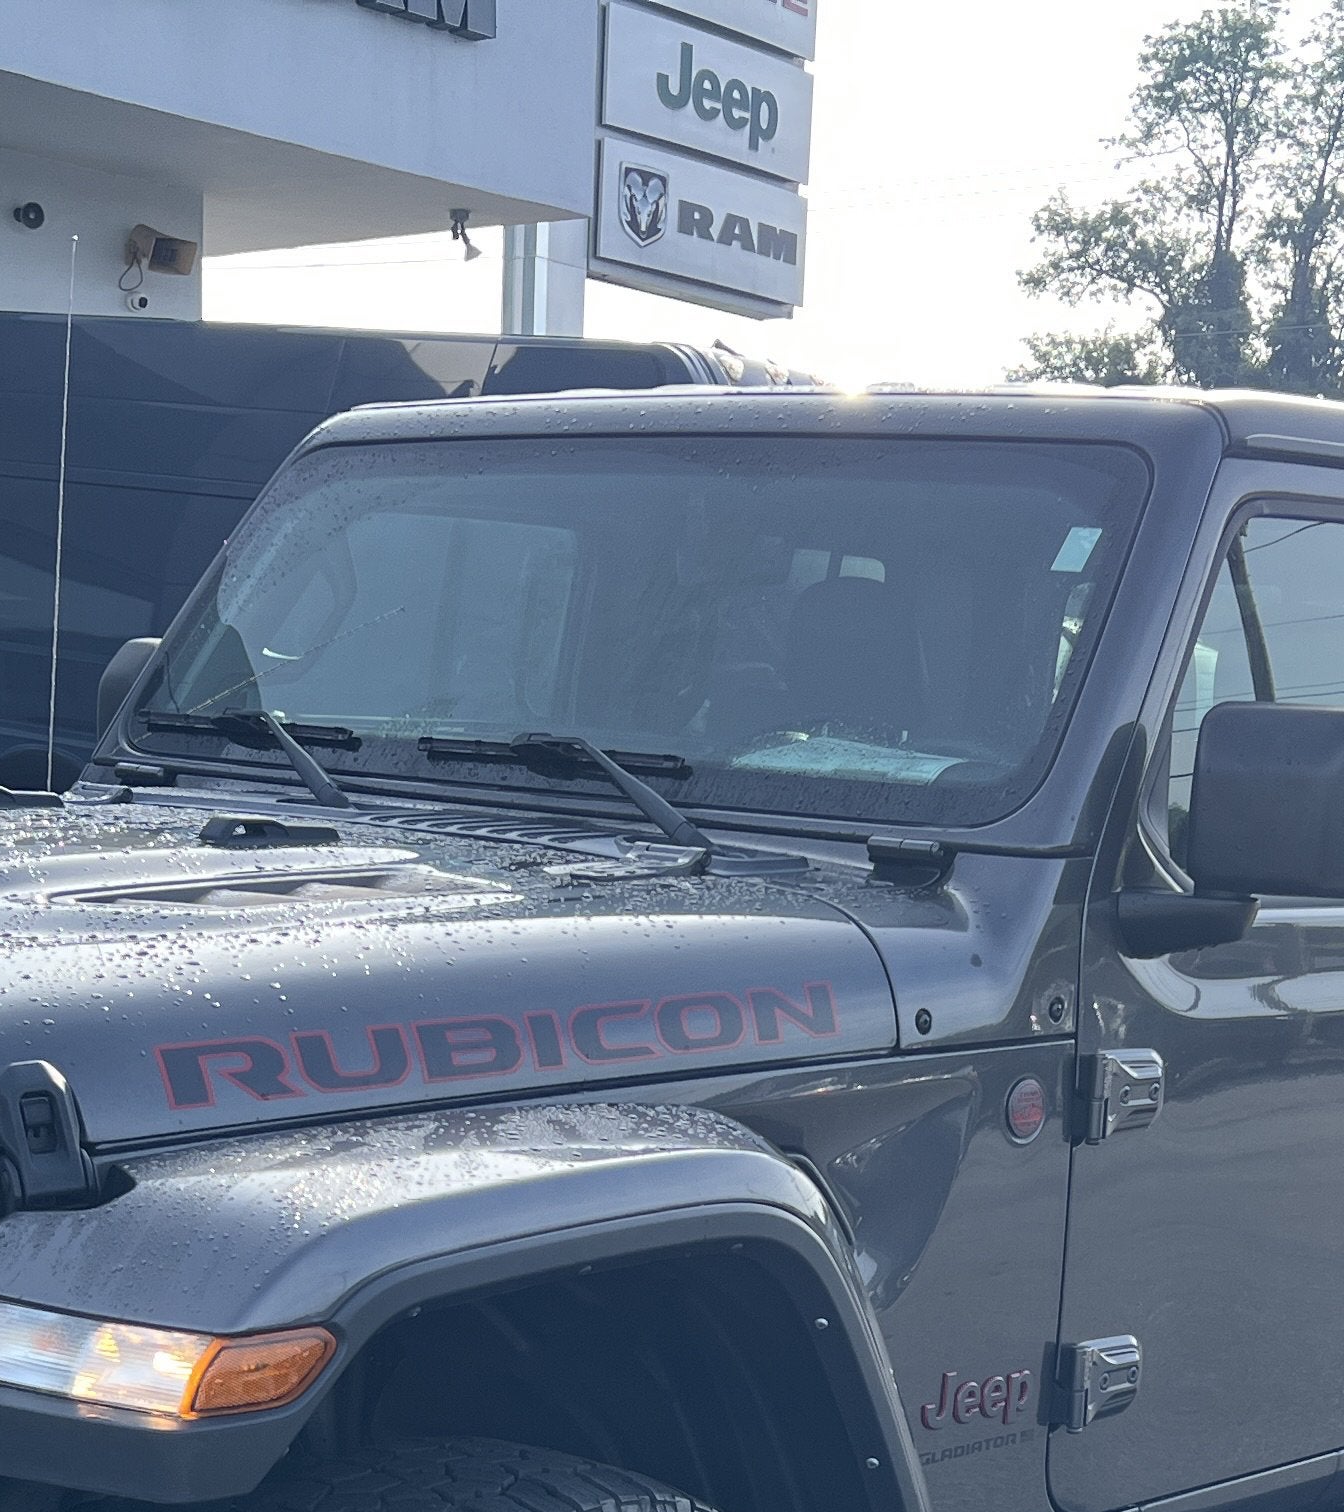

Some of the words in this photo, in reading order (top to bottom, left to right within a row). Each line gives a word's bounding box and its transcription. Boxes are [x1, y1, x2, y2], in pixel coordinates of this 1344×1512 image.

[656, 41, 778, 150] Jeep
[677, 199, 798, 266] RAM
[153, 980, 841, 1111] RUBICON
[921, 1369, 1031, 1430] Jeep
[919, 1433, 1017, 1466] GLADIATOR
